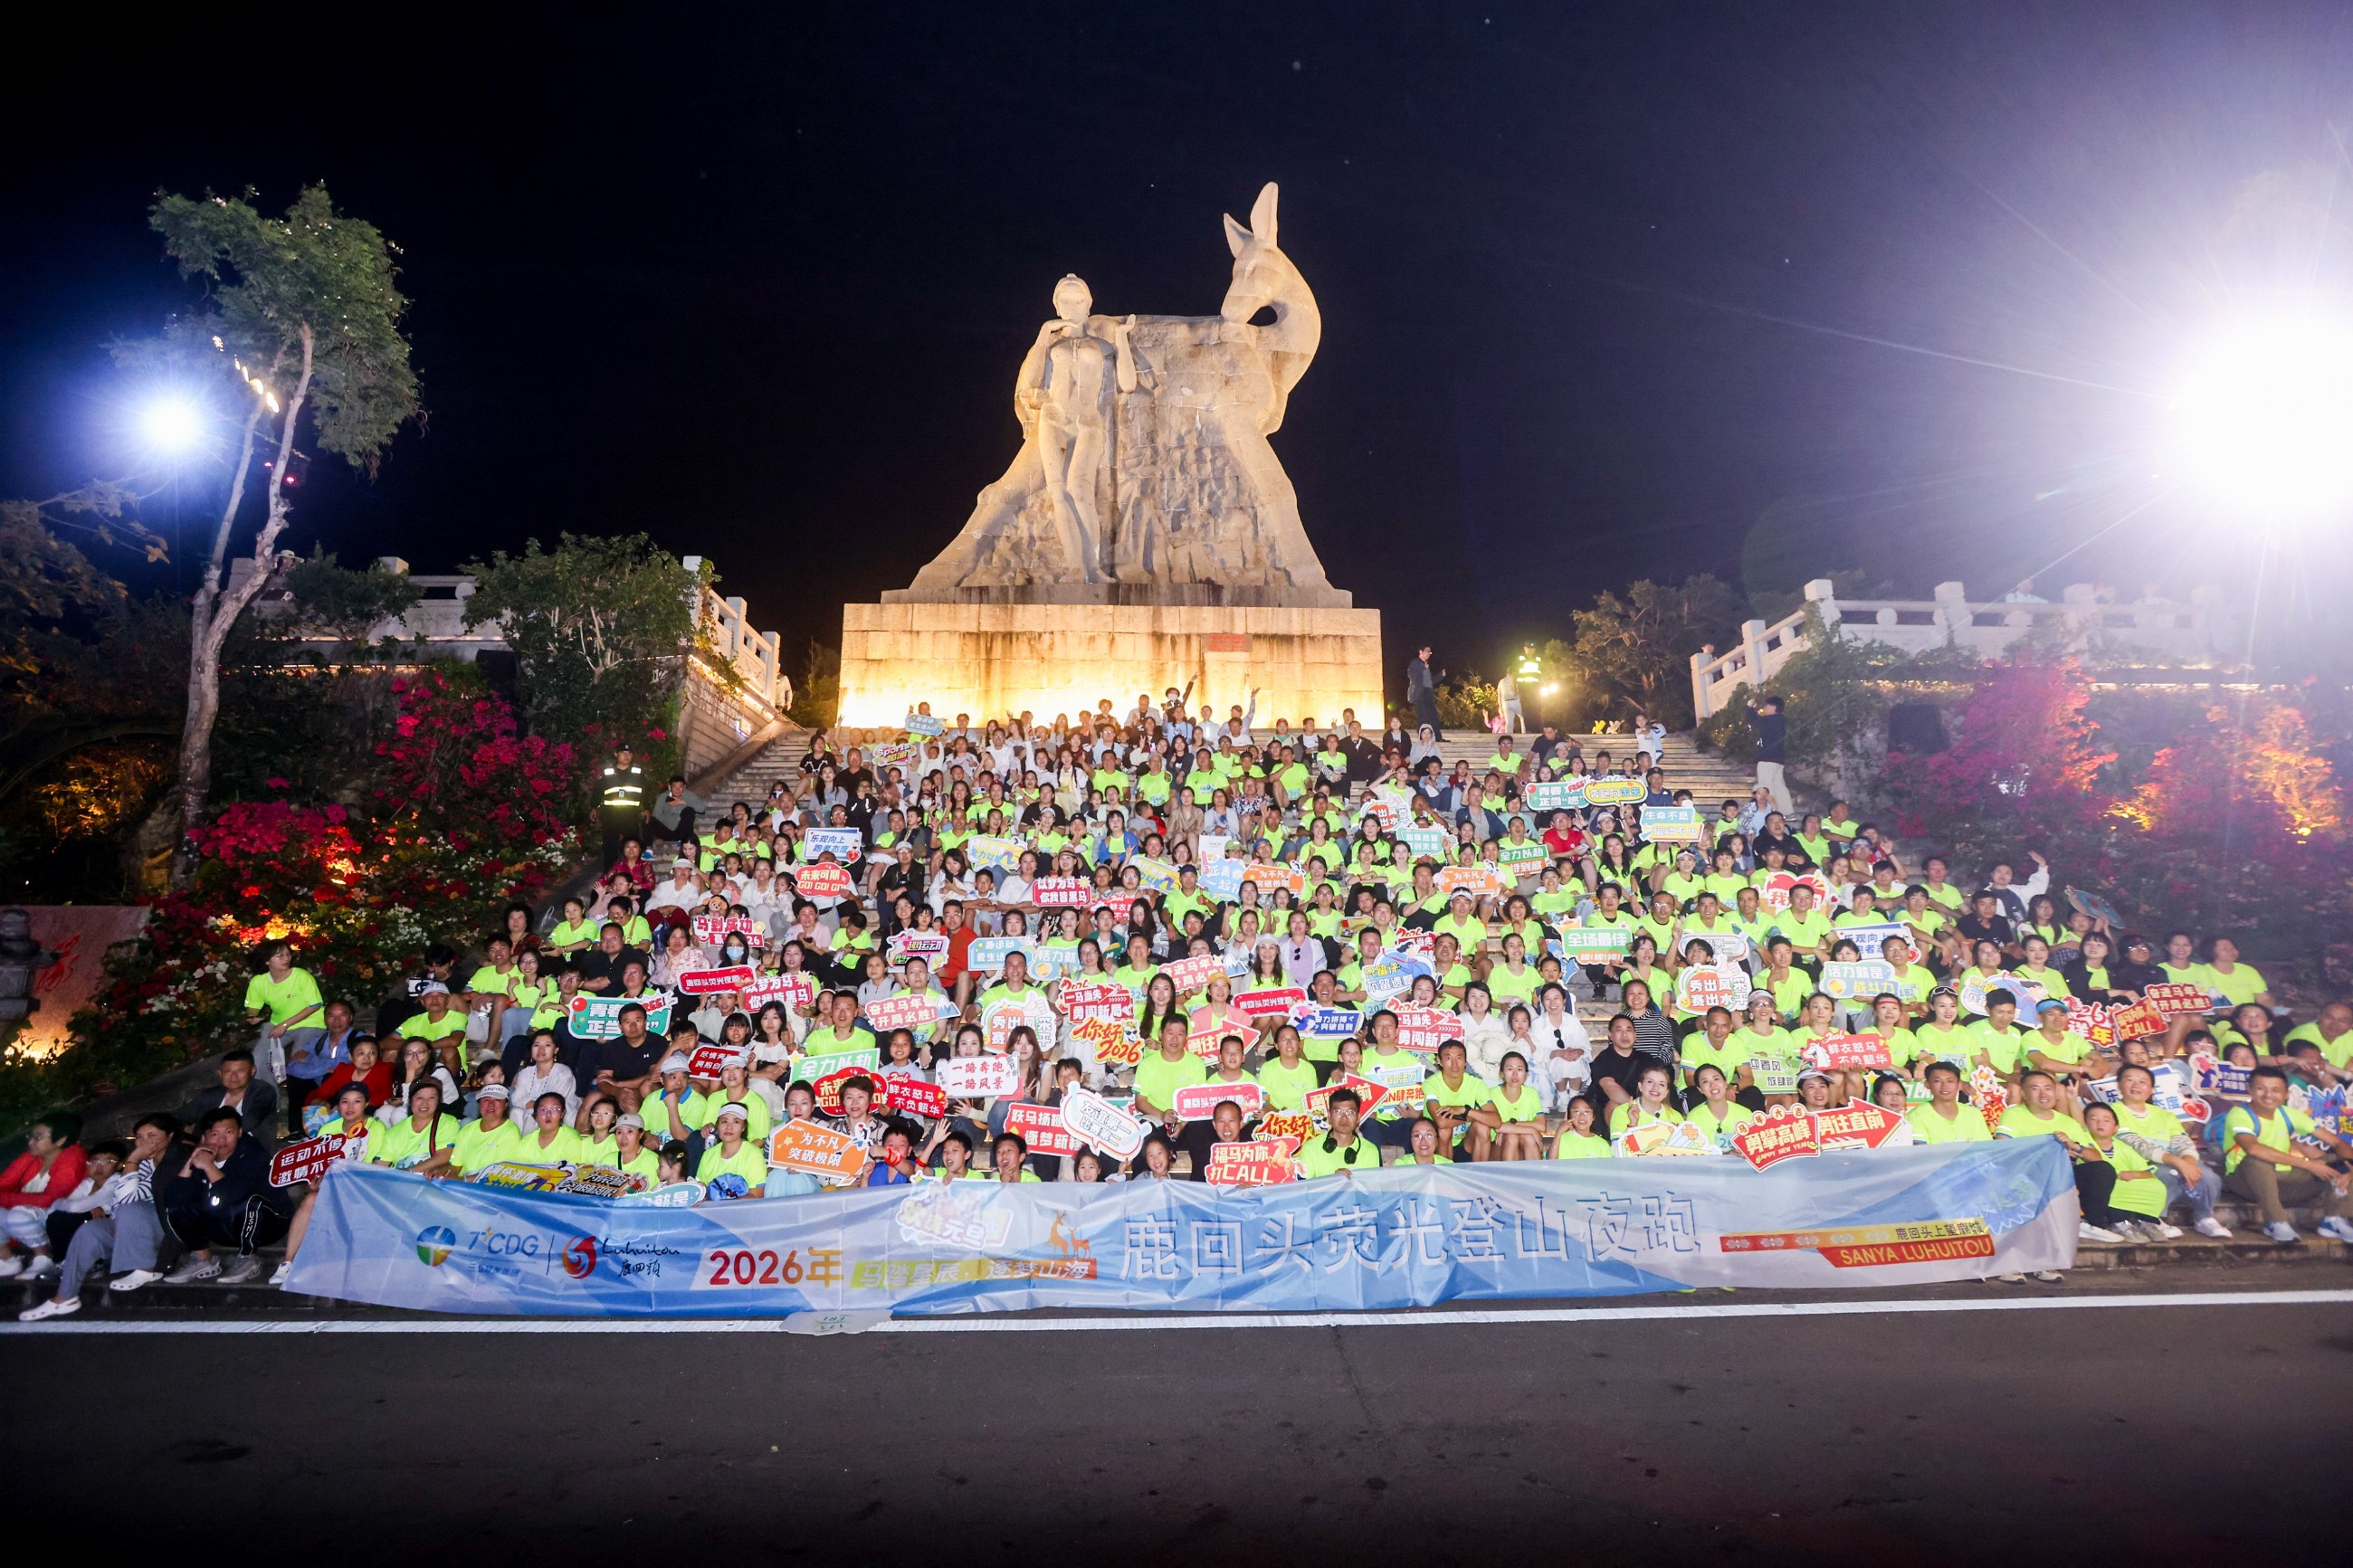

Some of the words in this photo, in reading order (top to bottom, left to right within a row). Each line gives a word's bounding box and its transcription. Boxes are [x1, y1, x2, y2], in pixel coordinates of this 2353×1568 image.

[878, 743, 911, 757] Sports
[1590, 787, 1642, 798] 奔跑向未来
[1645, 811, 1690, 822] 生命不息
[1653, 826, 1698, 836] 运动不止
[811, 834, 845, 844] 乐观向上
[813, 844, 850, 854] 跑者态度
[1500, 847, 1544, 861] 全力以赴
[800, 870, 840, 880] 未来可期
[798, 881, 814, 889] GO!
[814, 882, 830, 891] GO!
[1037, 877, 1076, 889] 以梦为马
[1040, 890, 1088, 903] 你我皆黑马
[697, 916, 753, 935] 马到成功
[1568, 932, 1626, 946] 全场最佳
[1161, 960, 1211, 977] 奋进马年
[1828, 965, 1884, 979] 活力就是
[1690, 978, 1748, 993] 秀出风采
[1853, 980, 1896, 994] 战斗力
[1065, 988, 1102, 1003] 一马当先
[1691, 992, 1749, 1006] 赛出水平
[869, 998, 923, 1016] 奋进马年
[877, 1009, 937, 1028] 开局必胜!
[1398, 1013, 1432, 1026] 马当先
[1072, 1017, 1124, 1041] 你好
[1320, 1022, 1354, 1031] 突破自我
[1098, 1040, 1141, 1063] 2026
[1826, 1041, 1878, 1056] 鲜衣怒马
[951, 1060, 1005, 1075] 一路奔跑
[1837, 1053, 1889, 1067] 不负韶华
[951, 1076, 1004, 1090] 一路风景
[1767, 1076, 1794, 1087] 放肆跑
[889, 1084, 936, 1103] 鲜衣怒马
[894, 1096, 941, 1116] 不负韶华
[1079, 1099, 1132, 1136] 友谊第一
[1818, 1108, 1886, 1136] 勇往直前
[1078, 1115, 1122, 1147] 比赛第二
[1258, 1113, 1310, 1138] 你好
[799, 1131, 841, 1151] 为不凡
[1744, 1118, 1812, 1155] 勇攀高峰
[280, 1138, 344, 1169] 运动不停
[787, 1146, 843, 1168] 突破极限
[1214, 1145, 1269, 1164] 福马为你
[1777, 1145, 1791, 1156] NEW
[1209, 1164, 1274, 1184] 打CALL
[1120, 1191, 1700, 1280] 鹿回头荧光登山夜跑
[1895, 1220, 1985, 1240] 鹿回头上望鹿城
[1840, 1241, 1900, 1267] SANYA
[1900, 1237, 1992, 1262] LUHUITOU
[709, 1246, 845, 1289] 2026年
